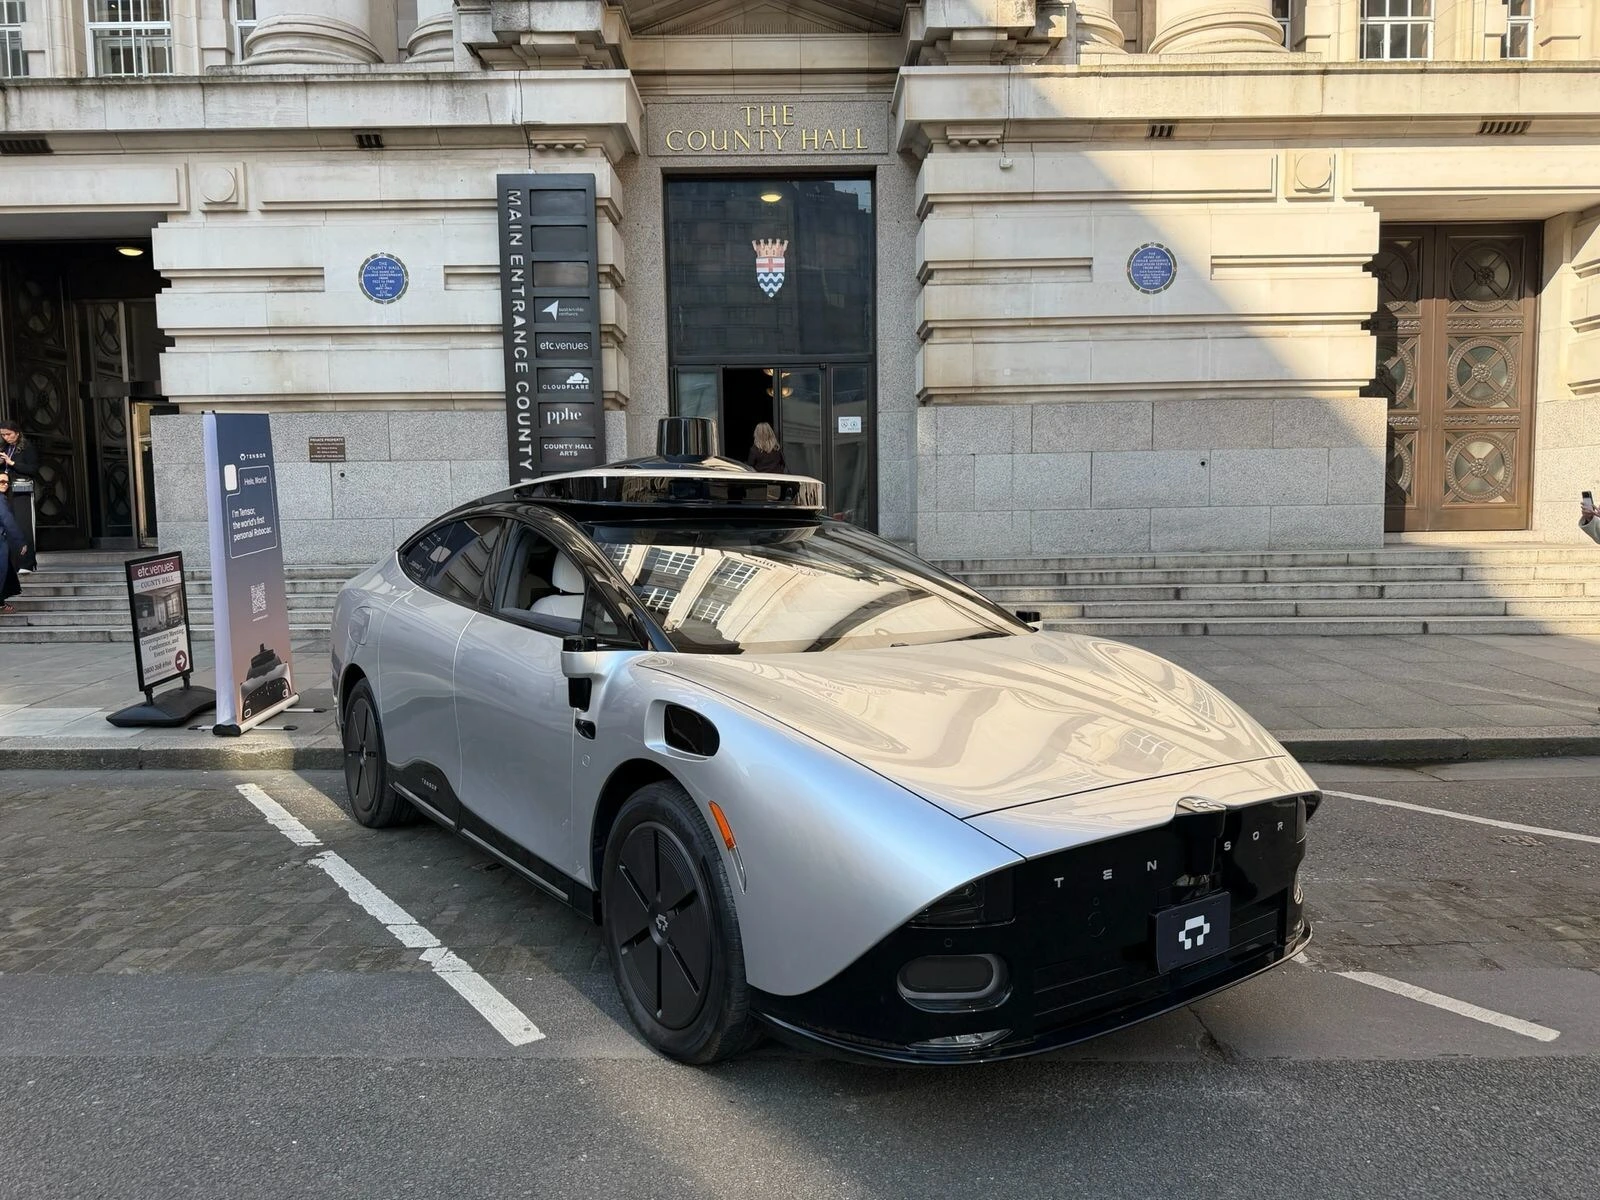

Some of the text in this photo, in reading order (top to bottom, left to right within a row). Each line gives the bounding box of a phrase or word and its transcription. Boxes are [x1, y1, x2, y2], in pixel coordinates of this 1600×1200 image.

[740, 105, 794, 127] THE
[666, 128, 868, 151] COUNTY HALL
[508, 190, 523, 246] MAIN
[510, 254, 529, 373] ENTRANCE
[540, 341, 589, 350] etc.venues
[547, 407, 582, 425] pphe
[516, 381, 533, 471] COUNTY
[246, 452, 267, 460] TENSOR
[232, 516, 266, 530] the world's first
[233, 529, 254, 543] personal
[137, 561, 175, 578] etc.venues
[140, 575, 175, 589] COUNTY HALL
[1054, 821, 1284, 889] TENSOR
